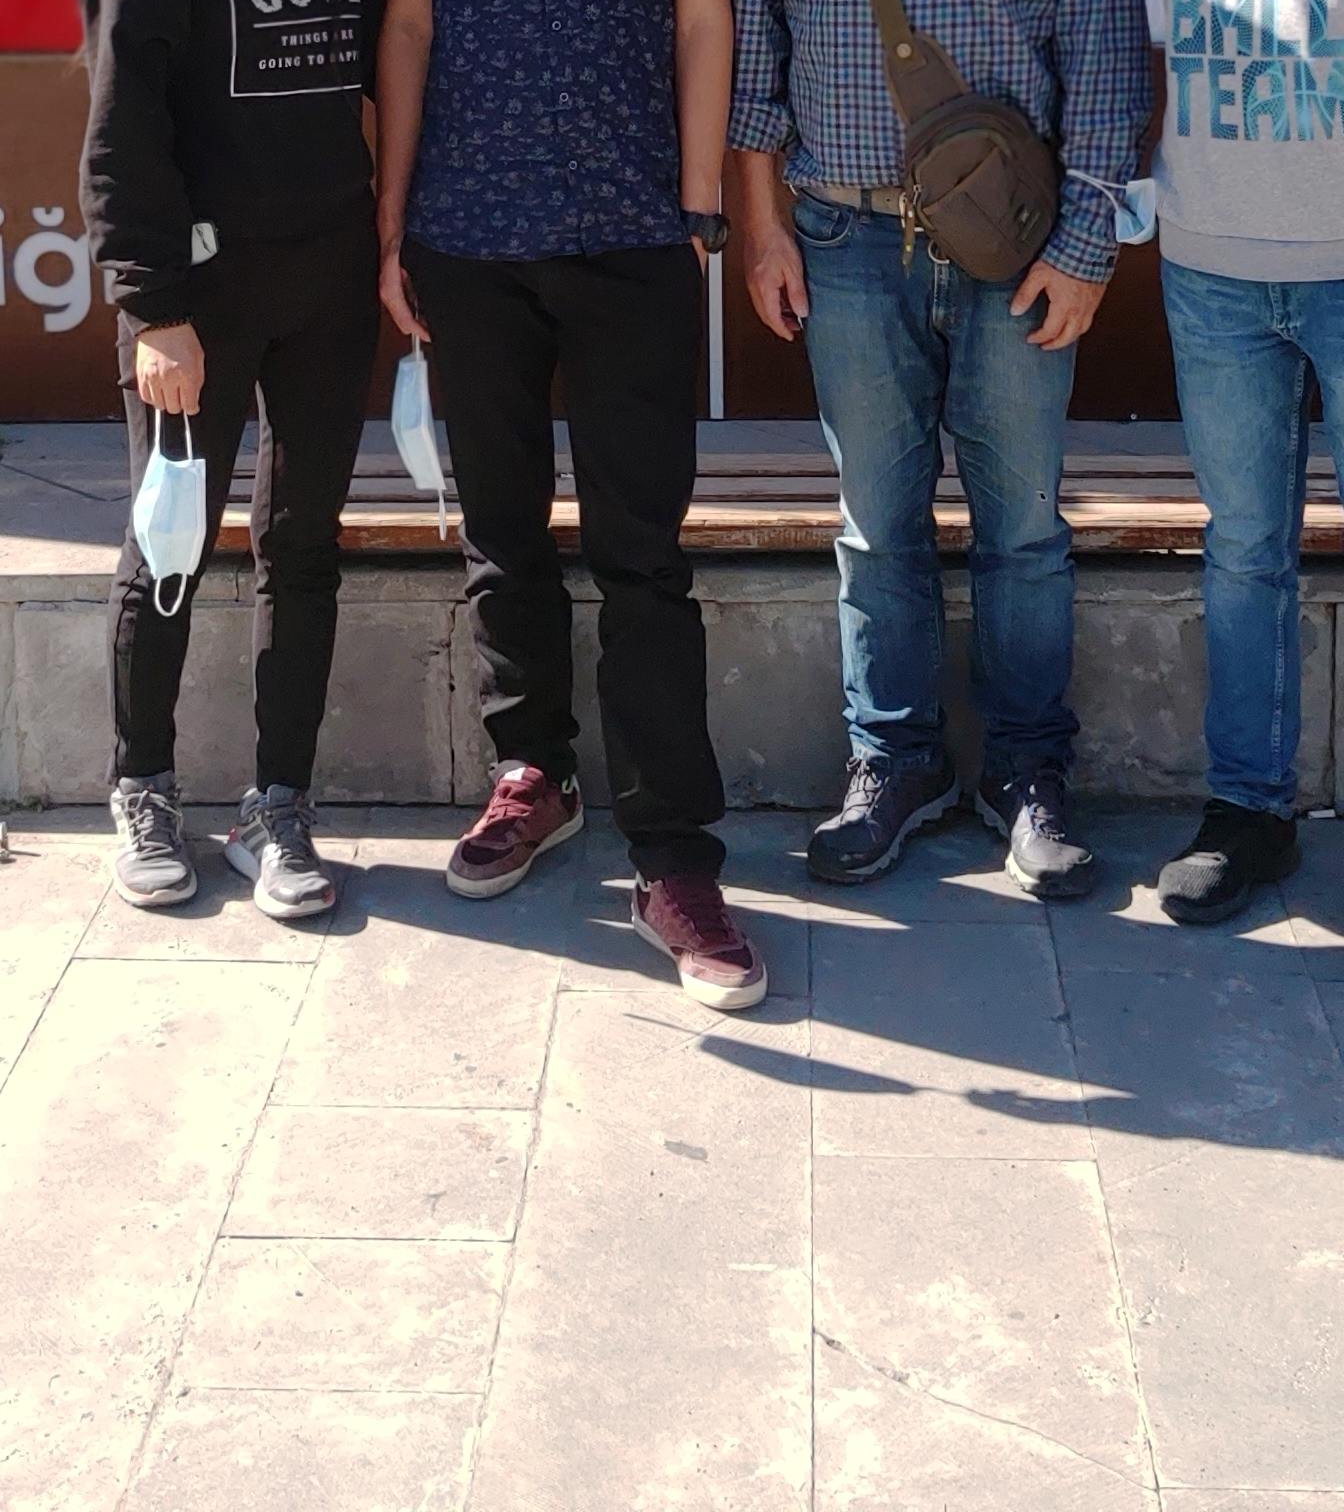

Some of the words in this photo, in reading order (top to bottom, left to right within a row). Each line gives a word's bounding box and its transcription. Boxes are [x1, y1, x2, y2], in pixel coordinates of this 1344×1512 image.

[280, 30, 329, 47] THINGS
[258, 55, 302, 70] GOING
[307, 53, 325, 66] TO
